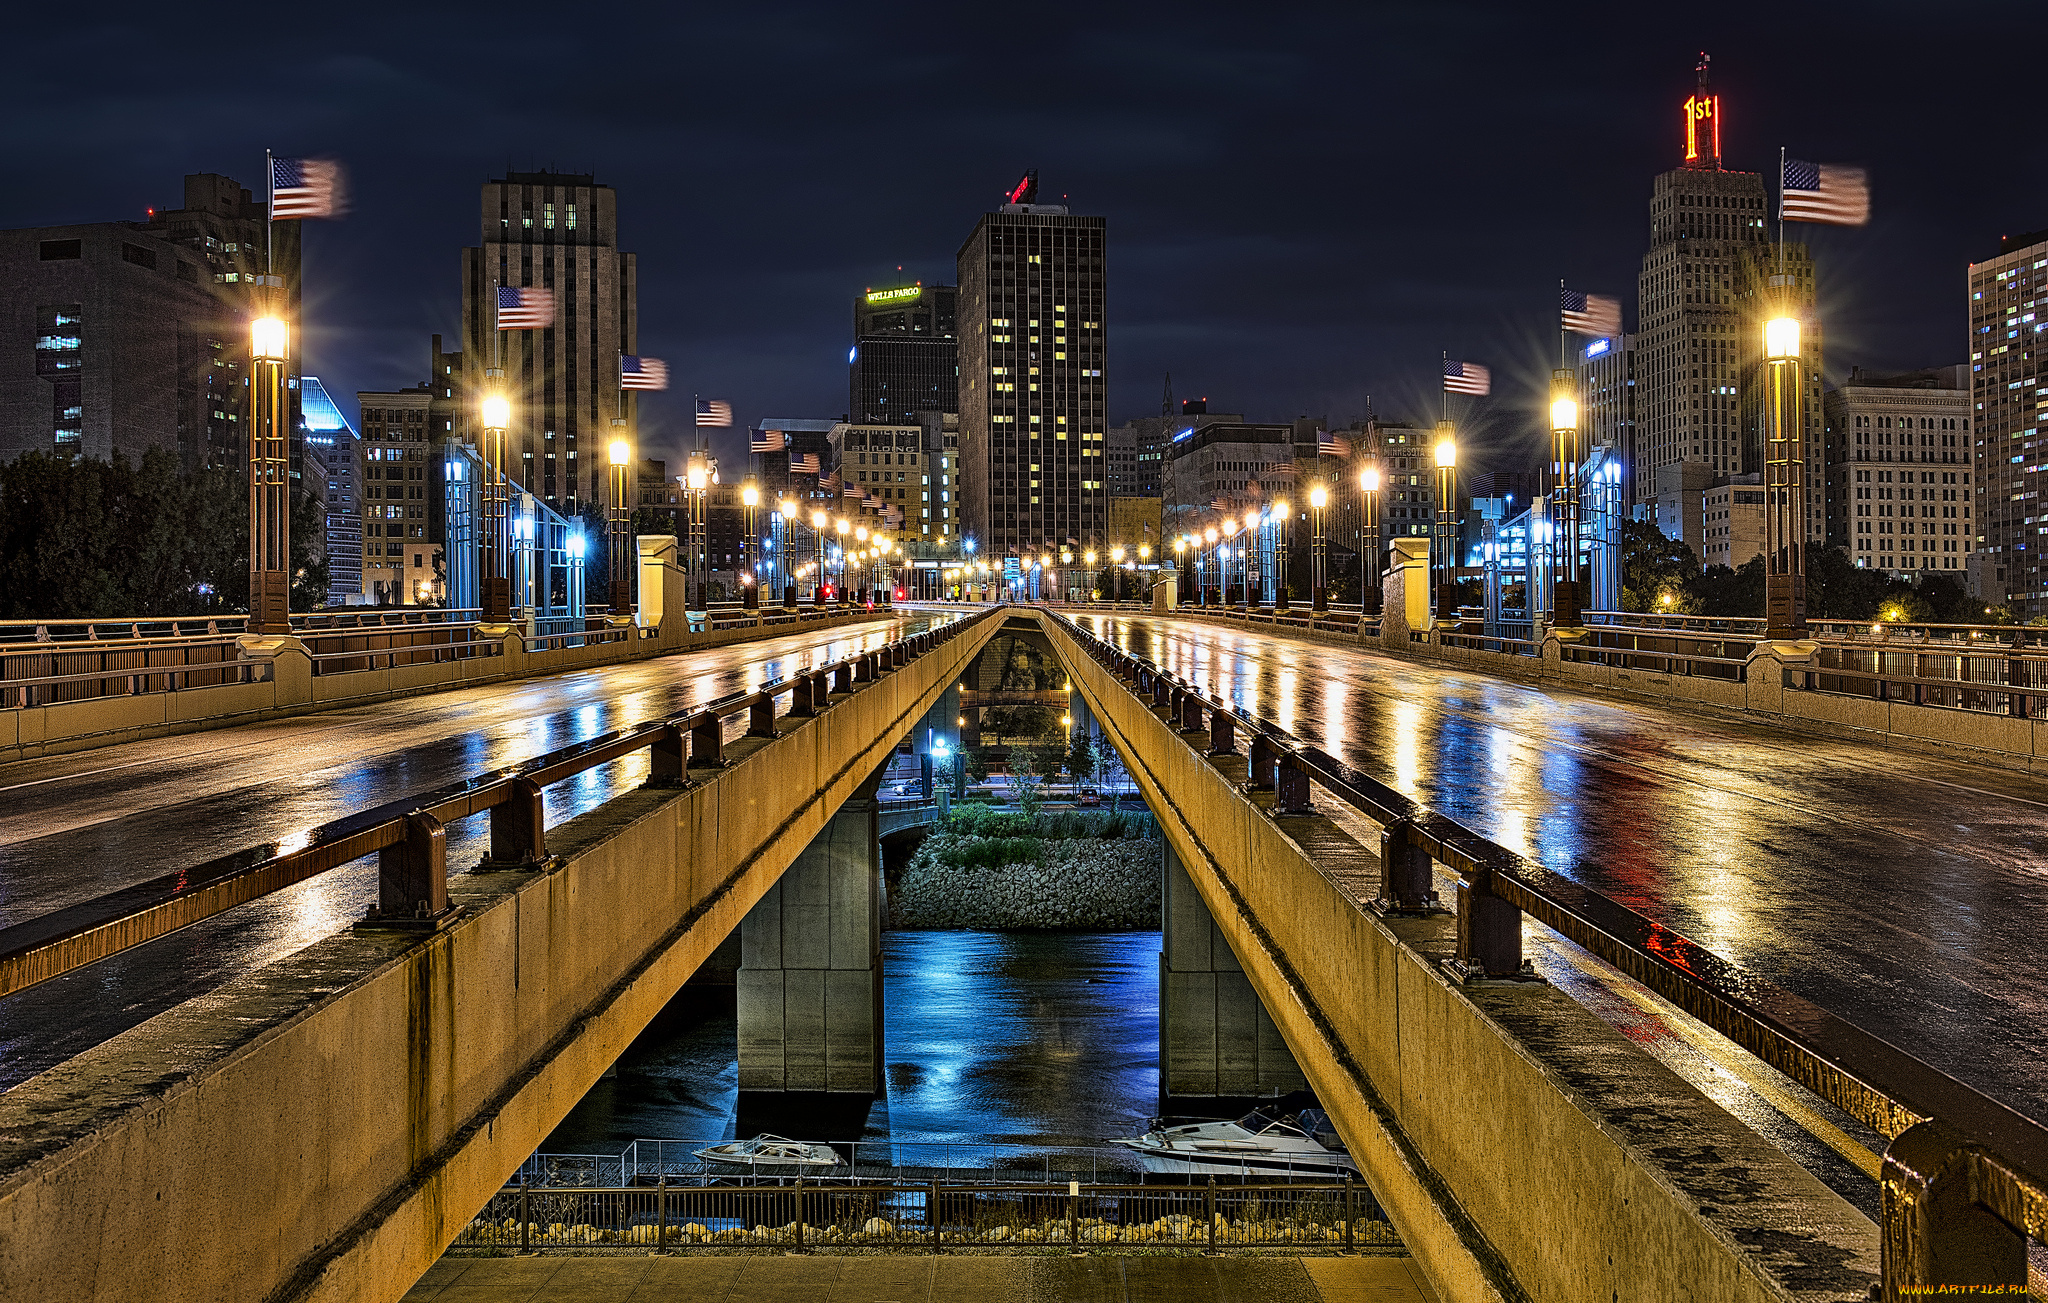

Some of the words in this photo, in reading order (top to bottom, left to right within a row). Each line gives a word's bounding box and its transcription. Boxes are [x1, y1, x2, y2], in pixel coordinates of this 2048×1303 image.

[1683, 95, 1712, 160] 1st
[867, 291, 894, 302] WELLS
[894, 287, 919, 298] FARGO
